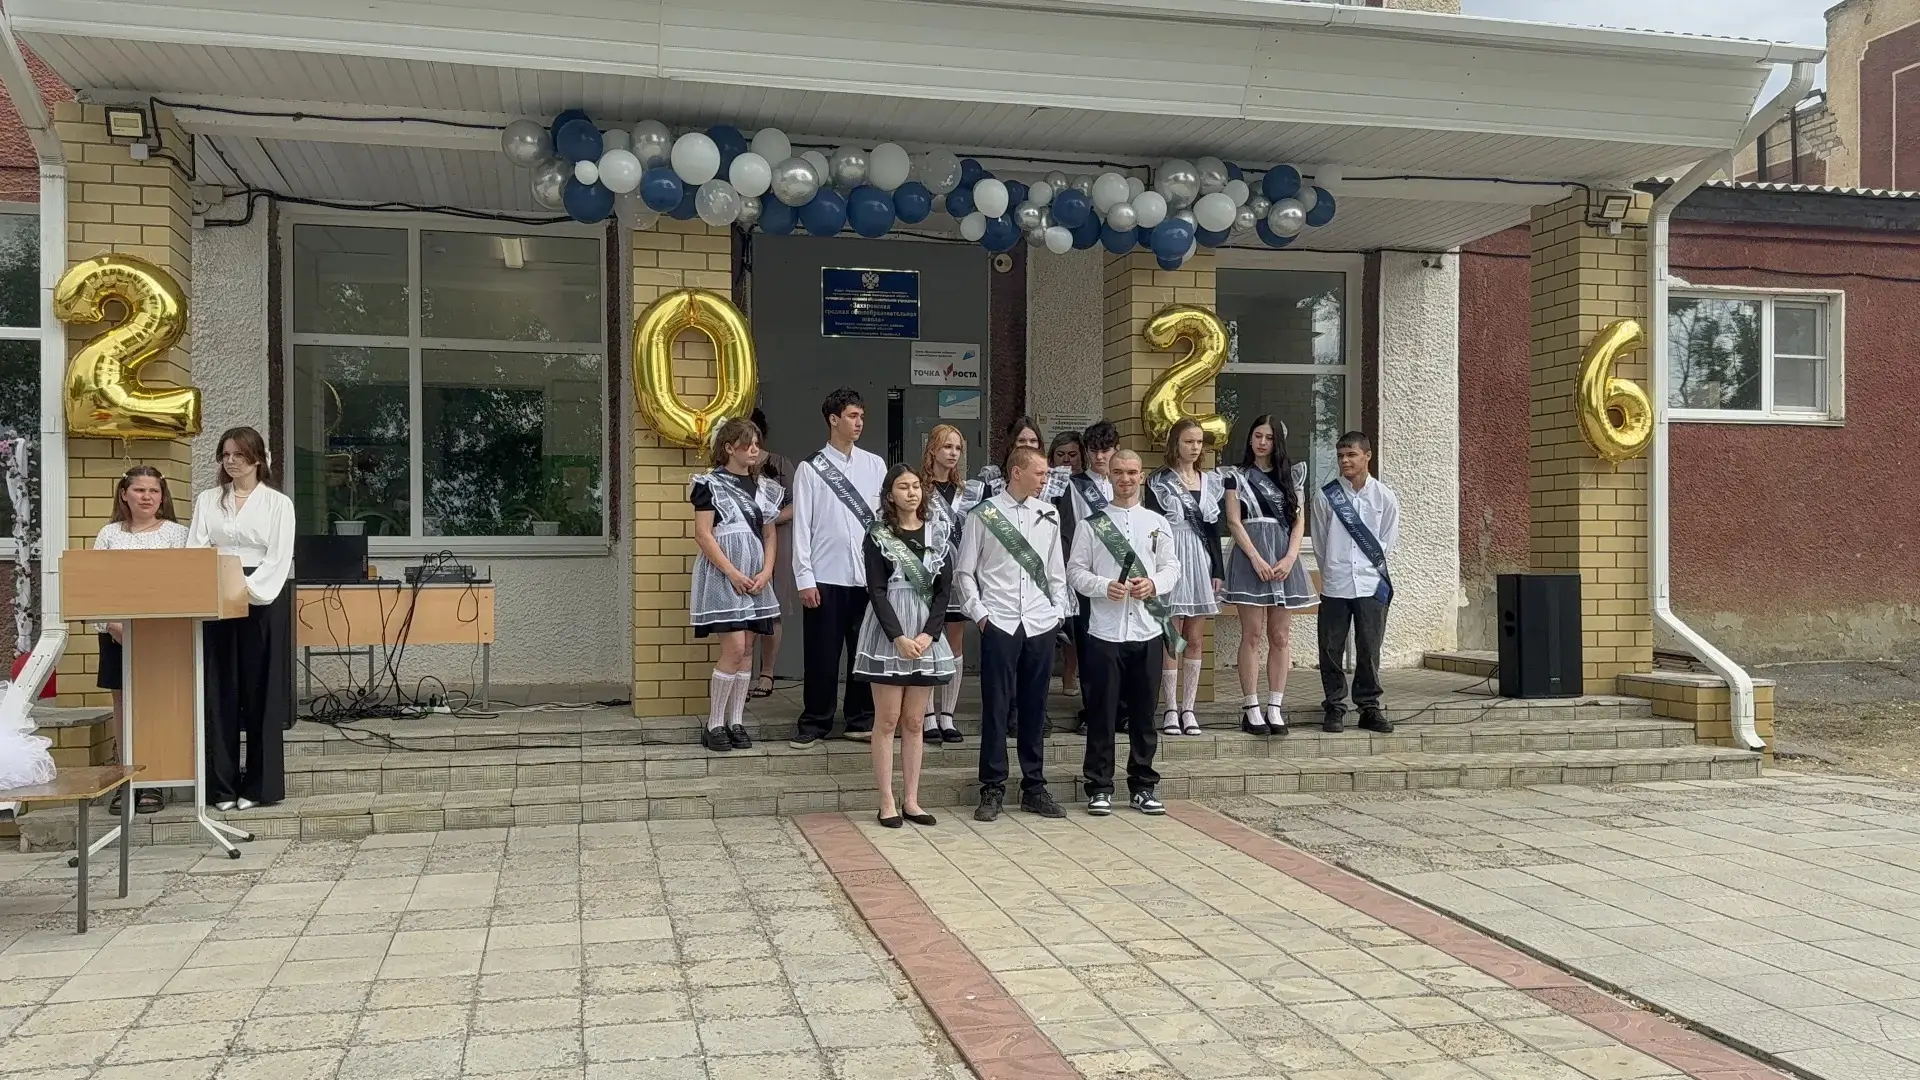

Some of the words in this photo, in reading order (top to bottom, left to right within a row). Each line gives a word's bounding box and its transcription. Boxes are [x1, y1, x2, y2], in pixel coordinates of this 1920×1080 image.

[53, 252, 202, 440] 2
[633, 288, 758, 449] 0
[1141, 303, 1230, 450] 2
[1575, 319, 1653, 464] 6
[913, 369, 940, 377] ТОЧКА
[826, 470, 865, 516] Выпускник
